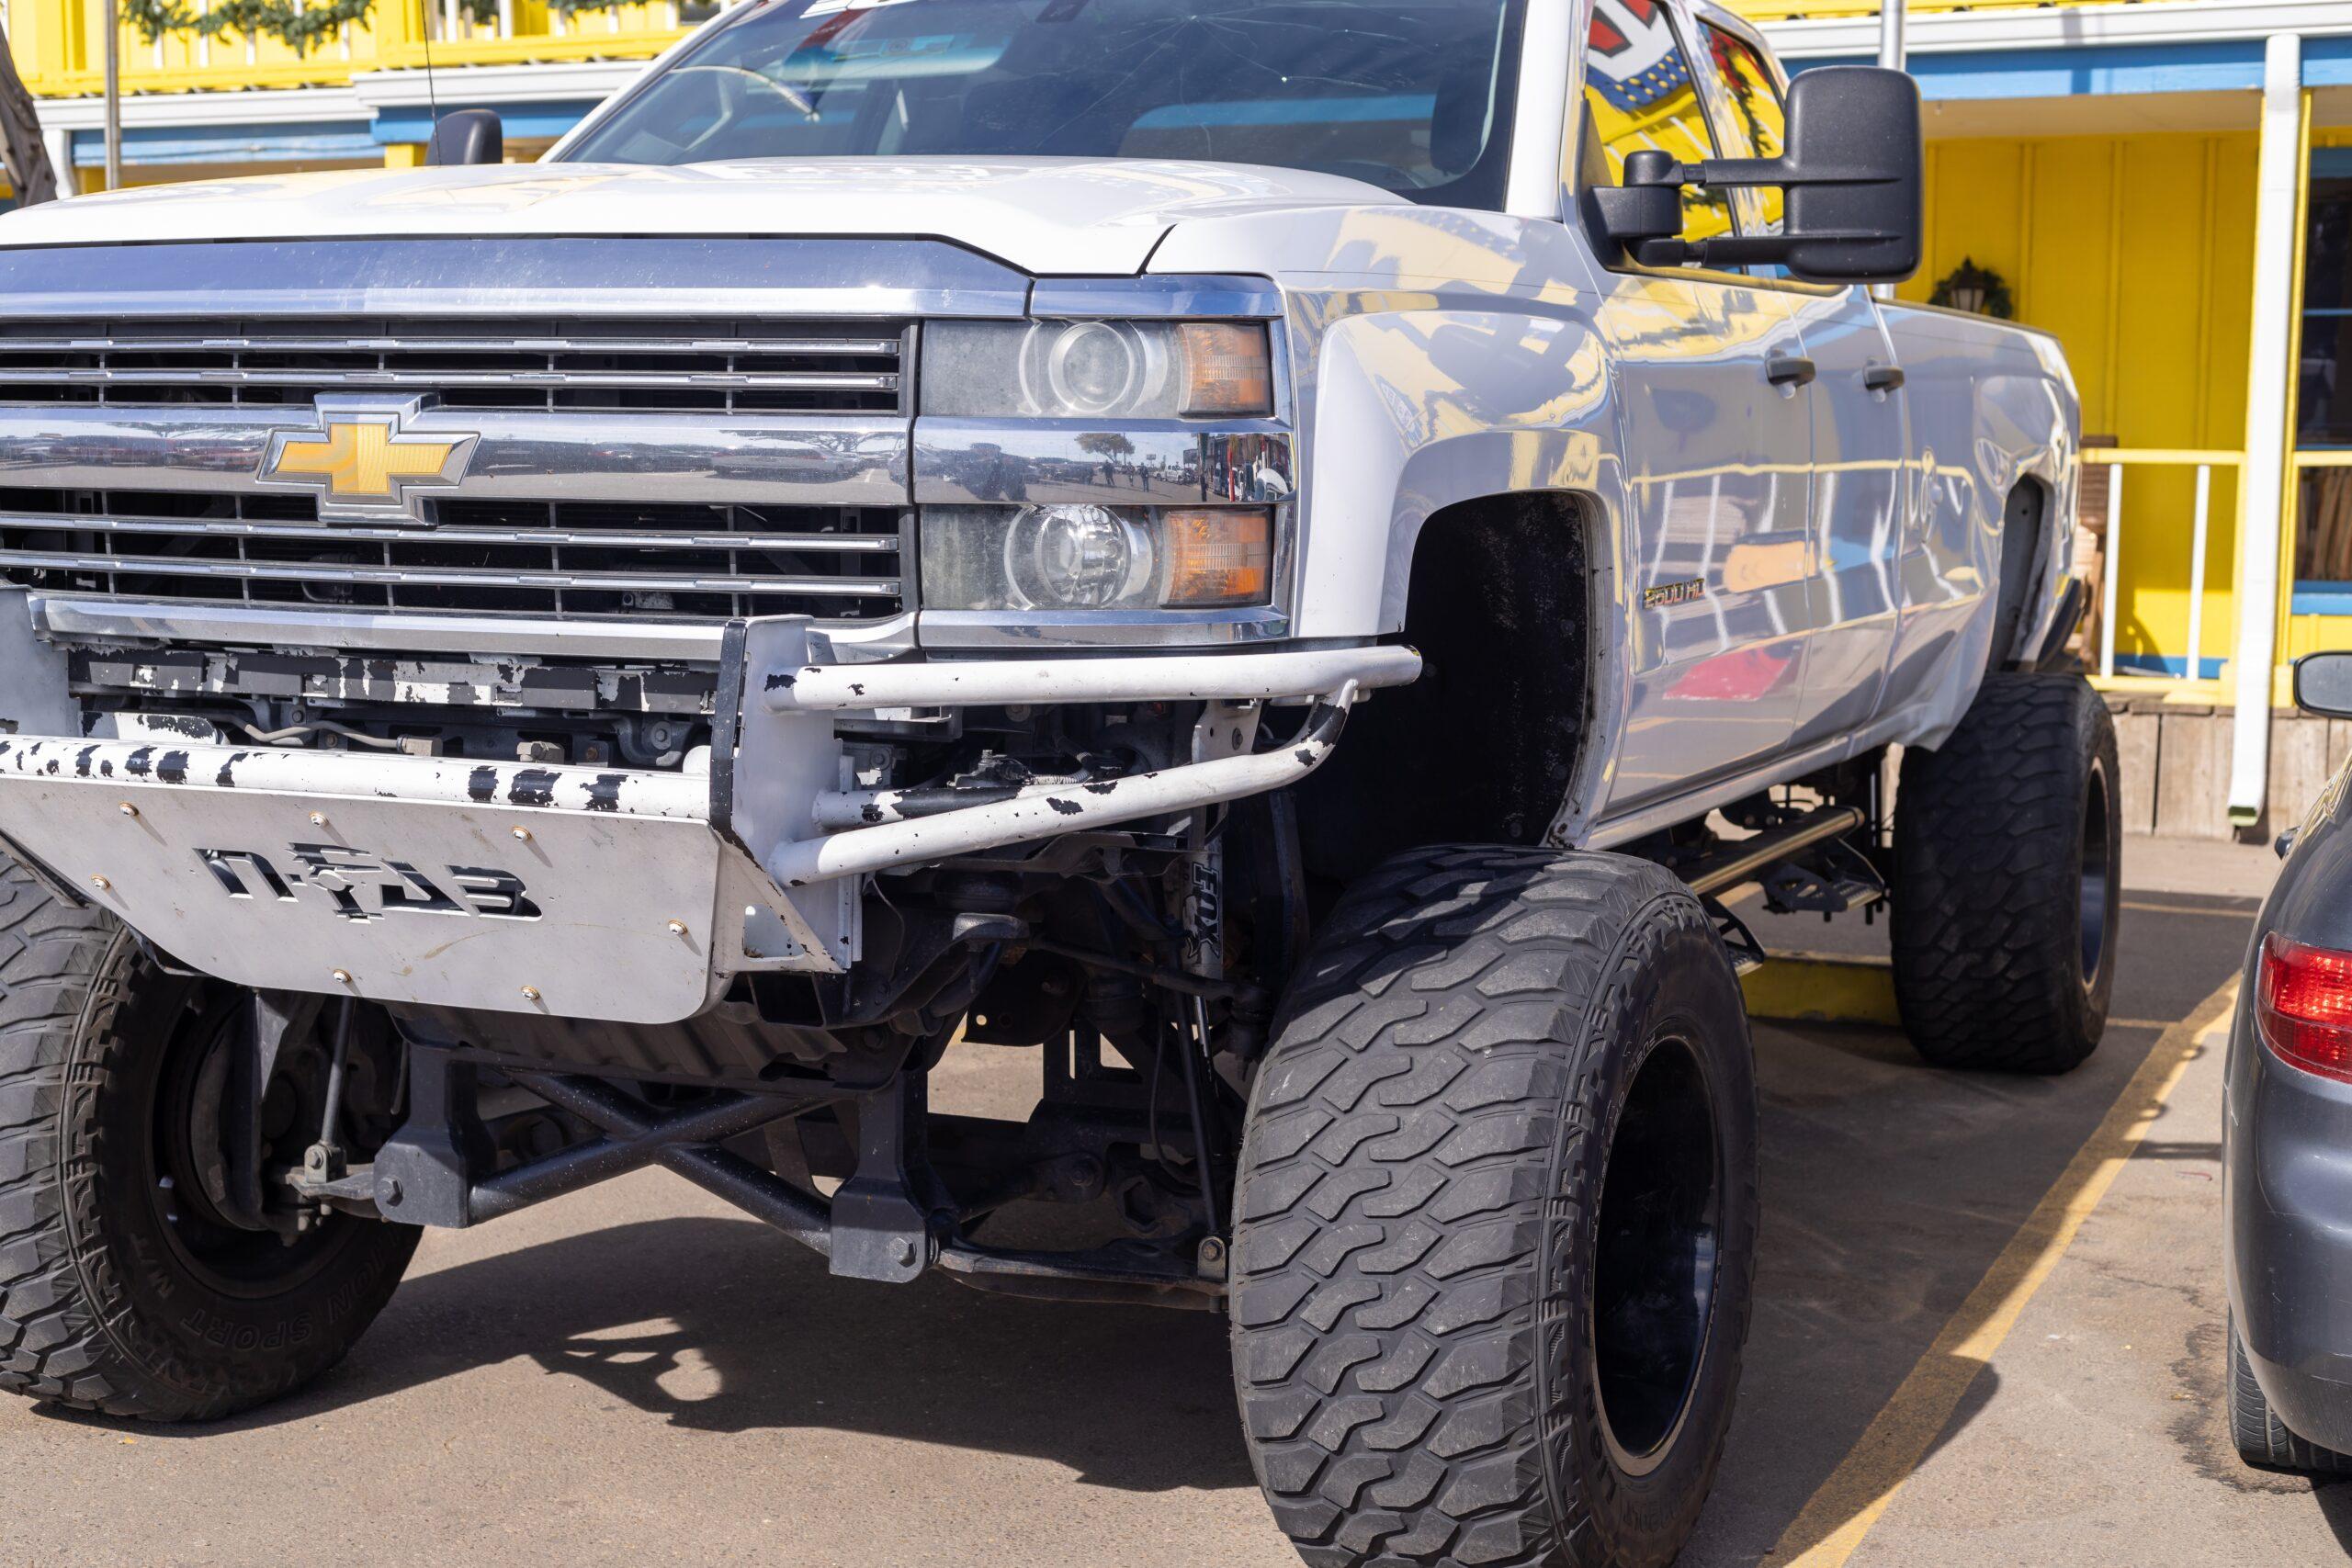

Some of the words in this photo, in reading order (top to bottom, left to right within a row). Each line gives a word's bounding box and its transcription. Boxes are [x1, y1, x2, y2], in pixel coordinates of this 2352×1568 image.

[1645, 582, 1683, 610] 2500
[1190, 862, 1221, 959] FOX
[180, 1307, 313, 1352] SPORT
